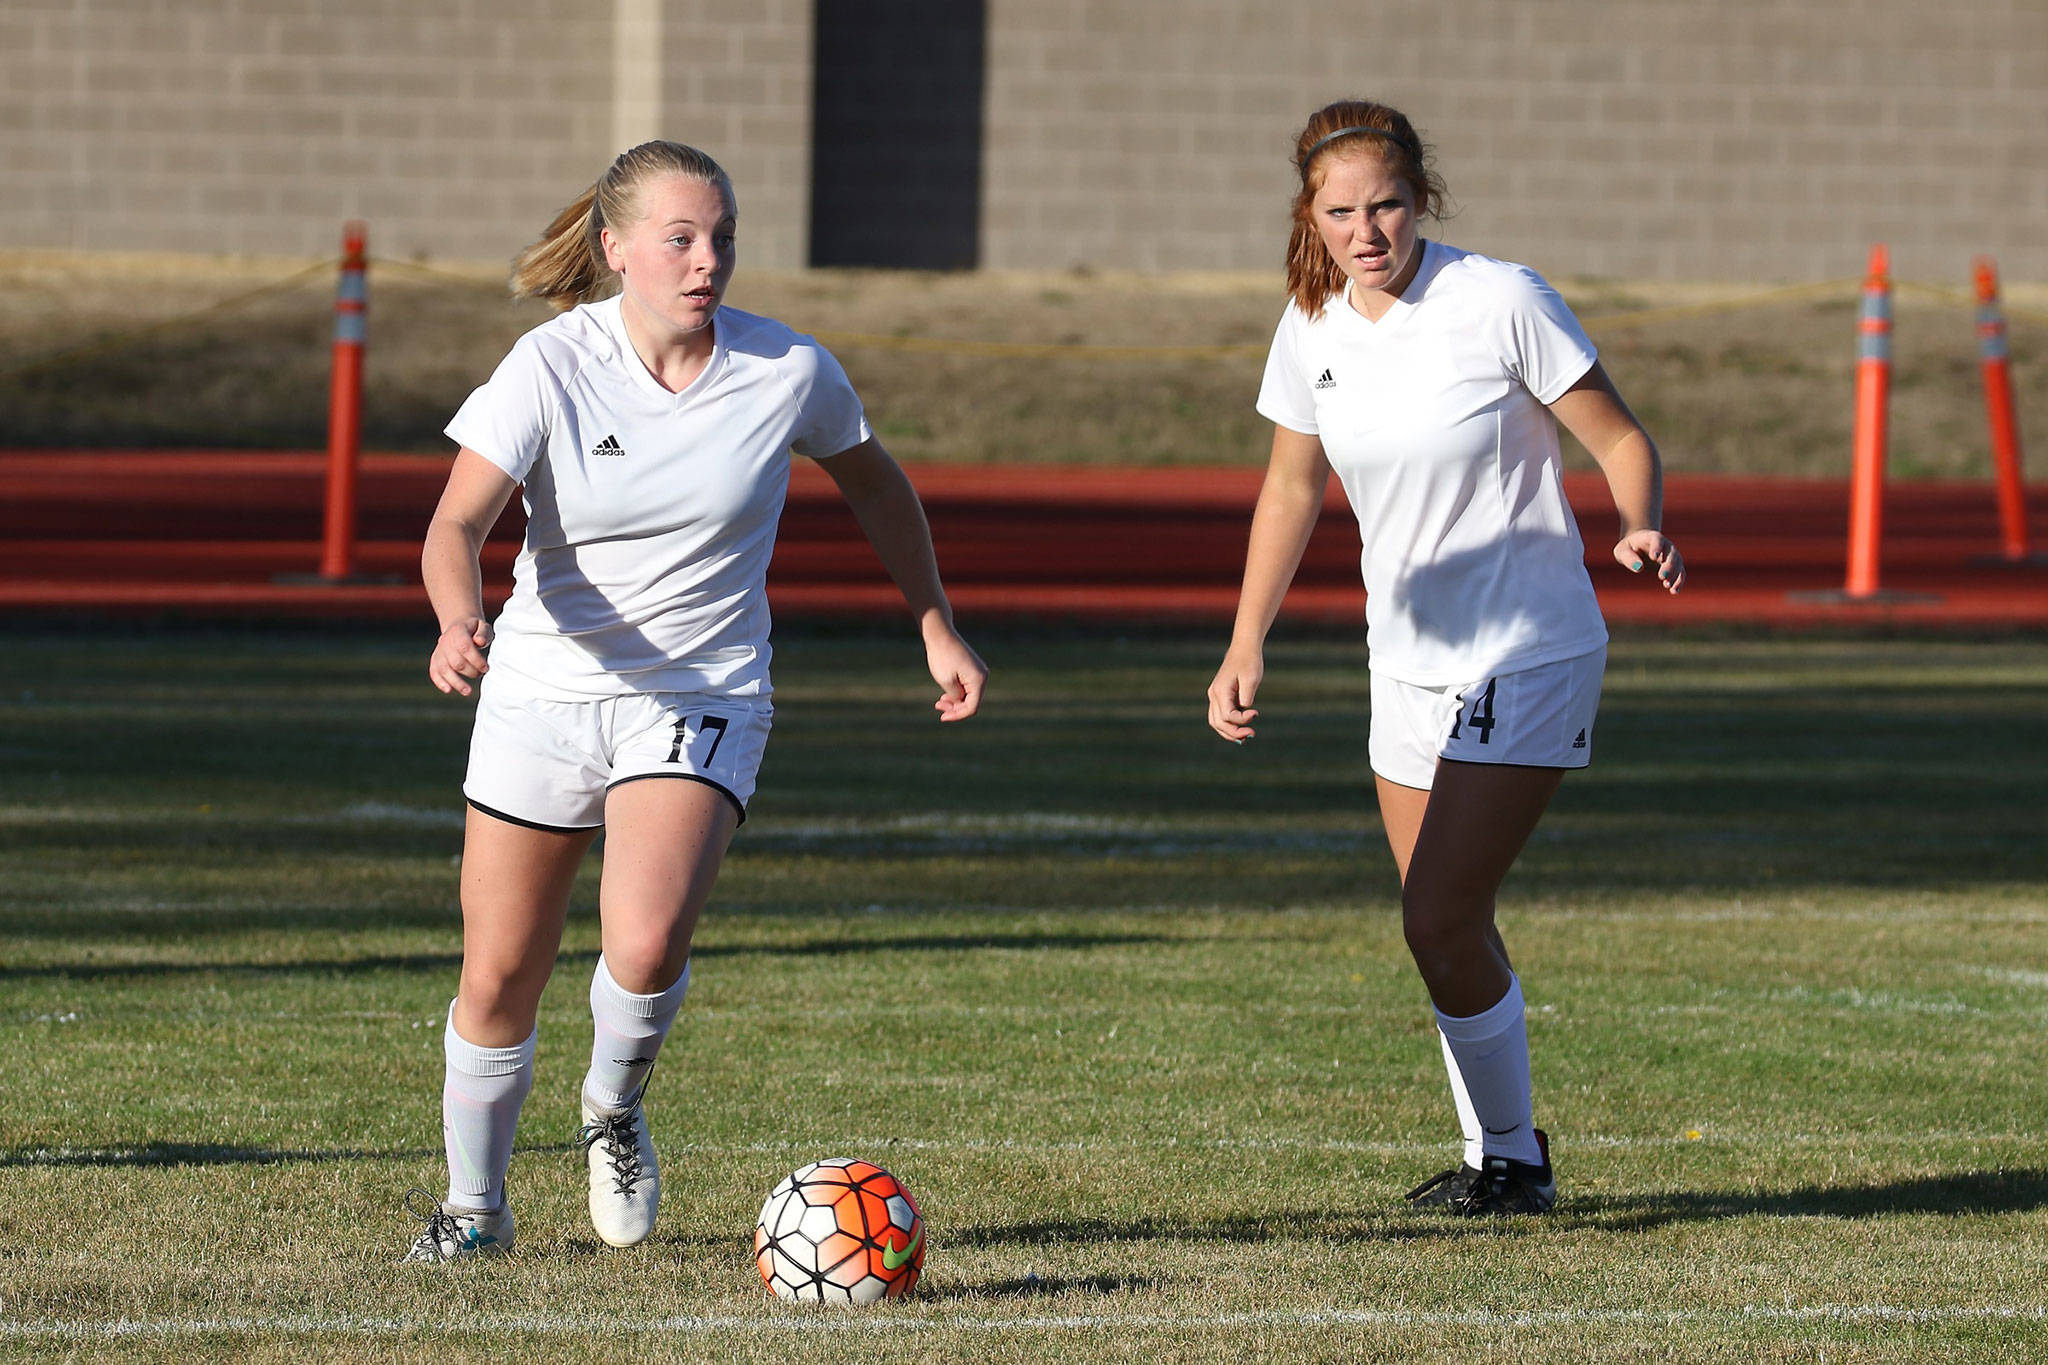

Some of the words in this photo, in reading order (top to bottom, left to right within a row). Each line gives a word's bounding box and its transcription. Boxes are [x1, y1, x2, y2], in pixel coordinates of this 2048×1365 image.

[591, 448, 625, 456] adidas
[1449, 676, 1497, 744] 14
[661, 715, 729, 769] 17
